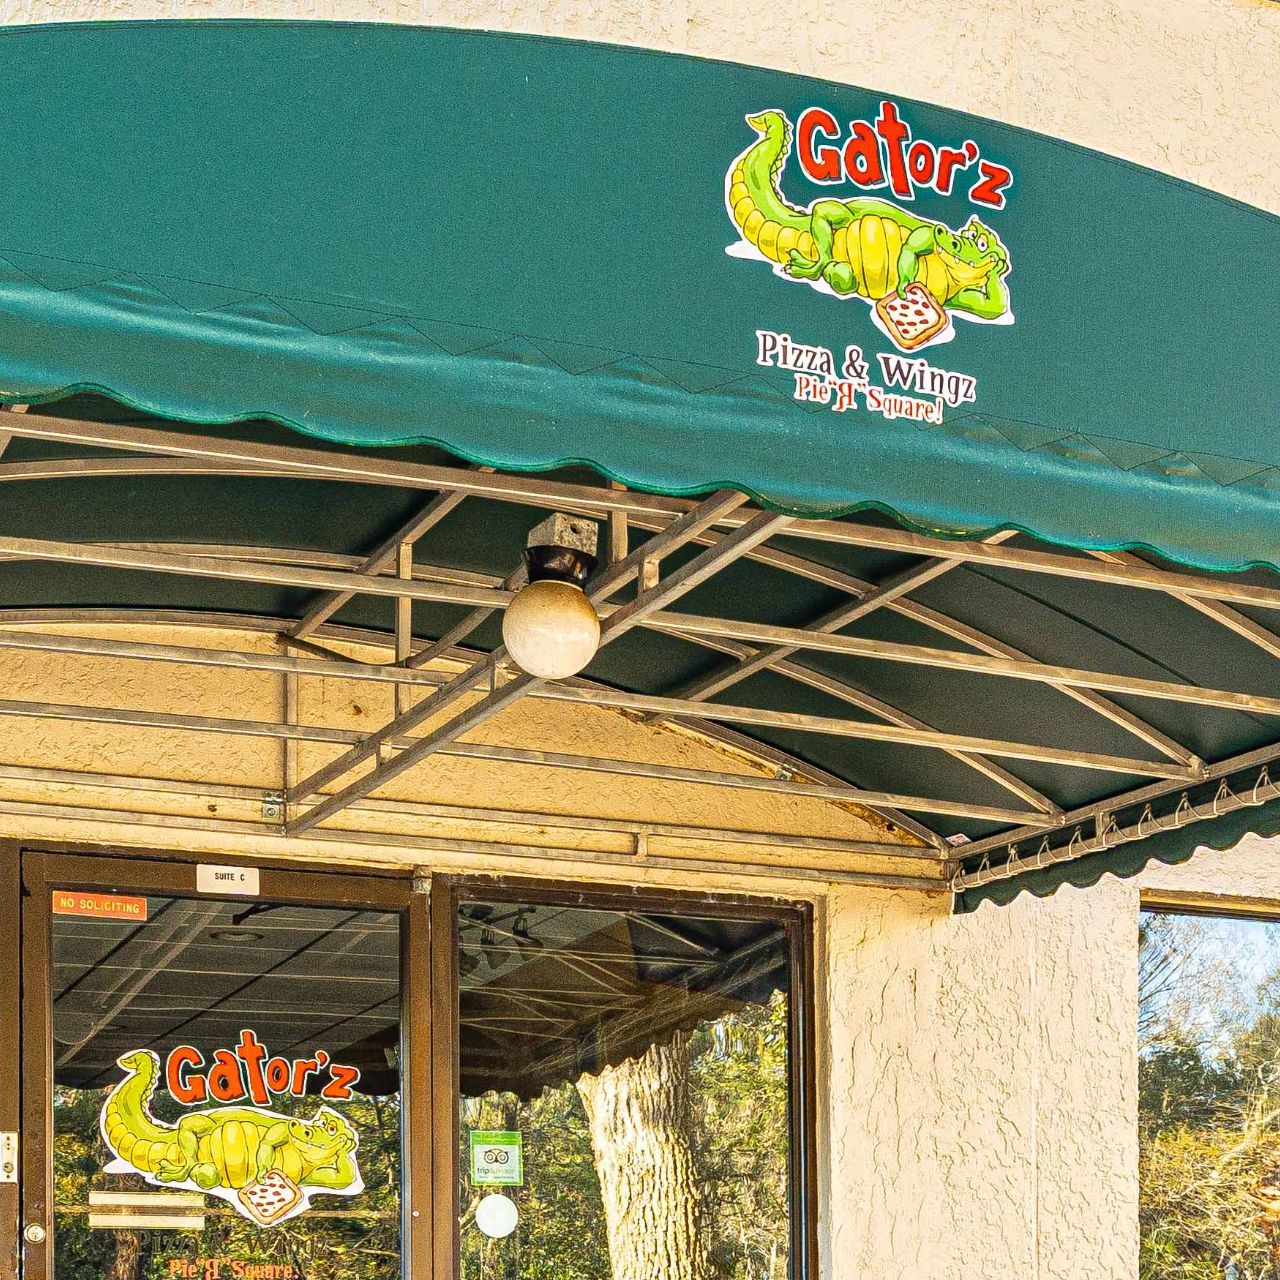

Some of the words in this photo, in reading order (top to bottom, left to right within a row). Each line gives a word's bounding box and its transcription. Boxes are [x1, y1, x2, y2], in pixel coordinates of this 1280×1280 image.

[797, 101, 1011, 206] Gator'z
[760, 333, 832, 376] Pizza
[844, 348, 866, 378] &
[880, 355, 974, 404] Wingz
[796, 376, 828, 399] Pie
[868, 388, 943, 422] Square!
[60, 898, 75, 908] NO
[79, 899, 140, 913] SOLICITING
[214, 872, 235, 881] SUITE
[239, 873, 245, 881] C
[166, 1029, 360, 1105] Gator'z
